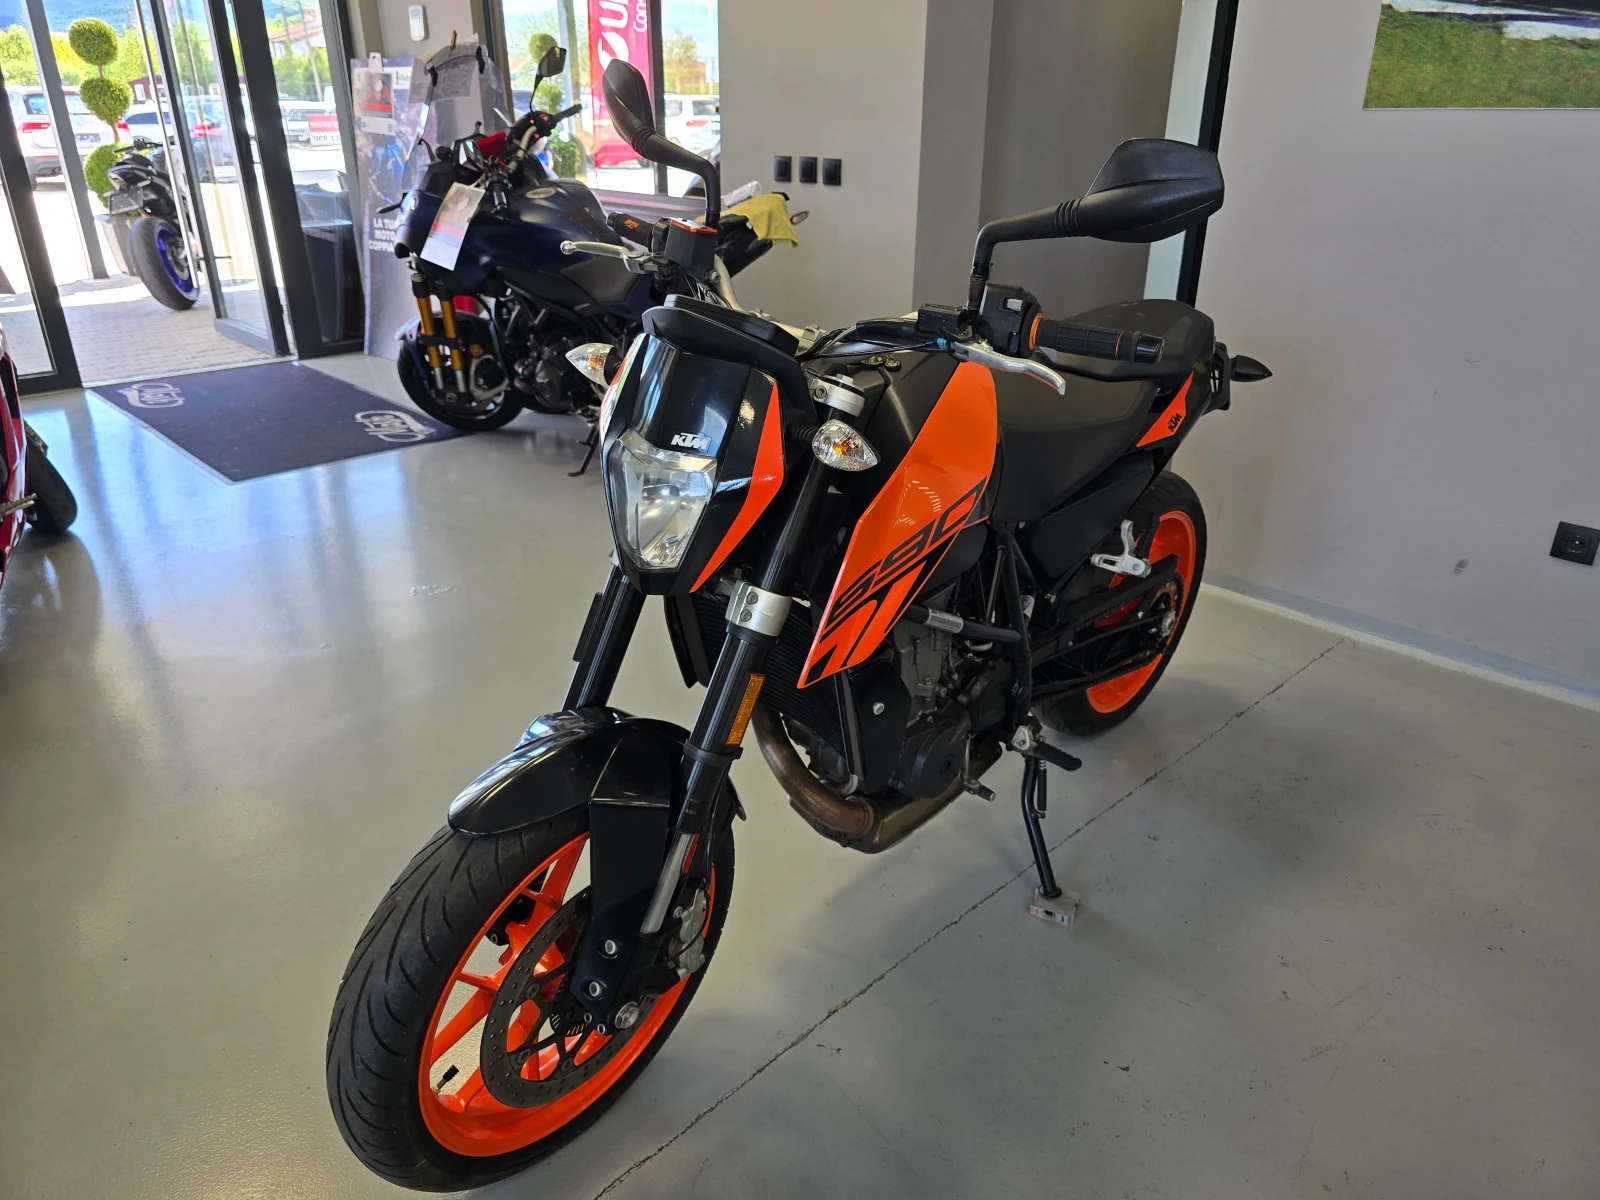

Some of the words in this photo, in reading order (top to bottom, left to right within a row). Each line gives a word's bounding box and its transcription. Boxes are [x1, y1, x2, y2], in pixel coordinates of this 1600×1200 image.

[633, 0, 647, 32] Con
[372, 217, 383, 229] LA
[374, 229, 395, 241] MOTO
[1167, 412, 1182, 432] KTM
[671, 432, 709, 450] KTM
[823, 476, 987, 630] 690
